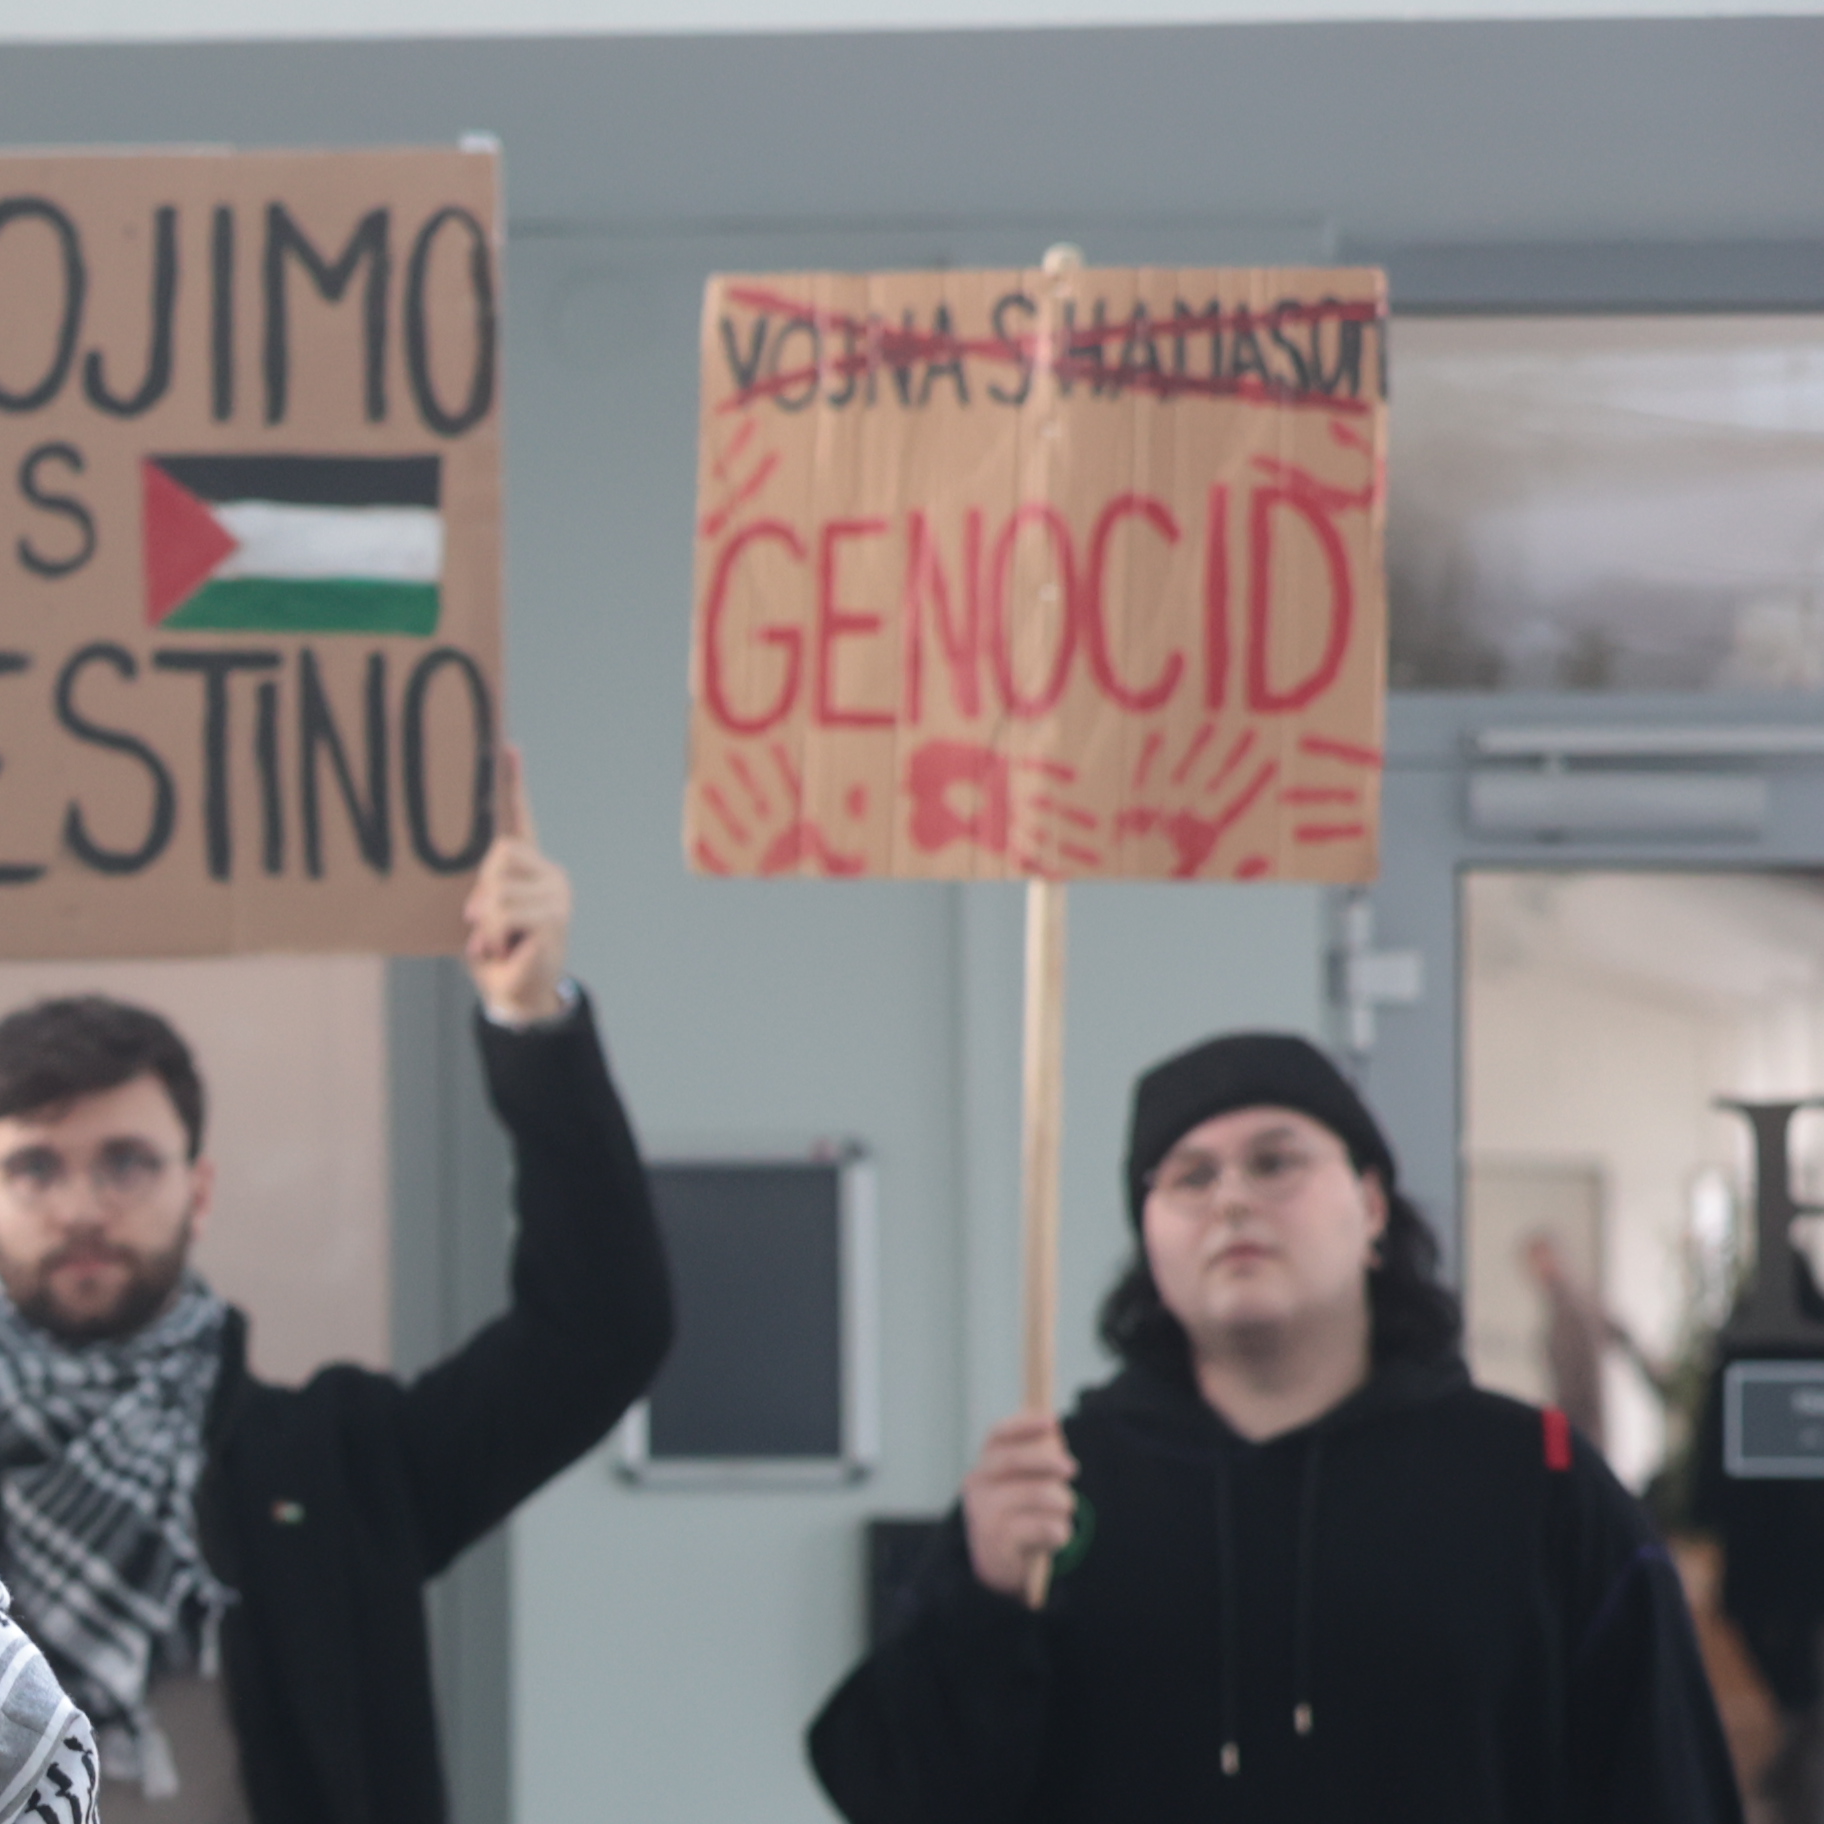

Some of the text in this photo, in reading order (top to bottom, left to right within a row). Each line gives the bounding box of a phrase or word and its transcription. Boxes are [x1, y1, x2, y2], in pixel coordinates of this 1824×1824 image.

[719, 298, 971, 413] VOJNA
[988, 293, 1037, 406] S
[16, 440, 97, 578] S
[703, 482, 1354, 737] GENOCID
